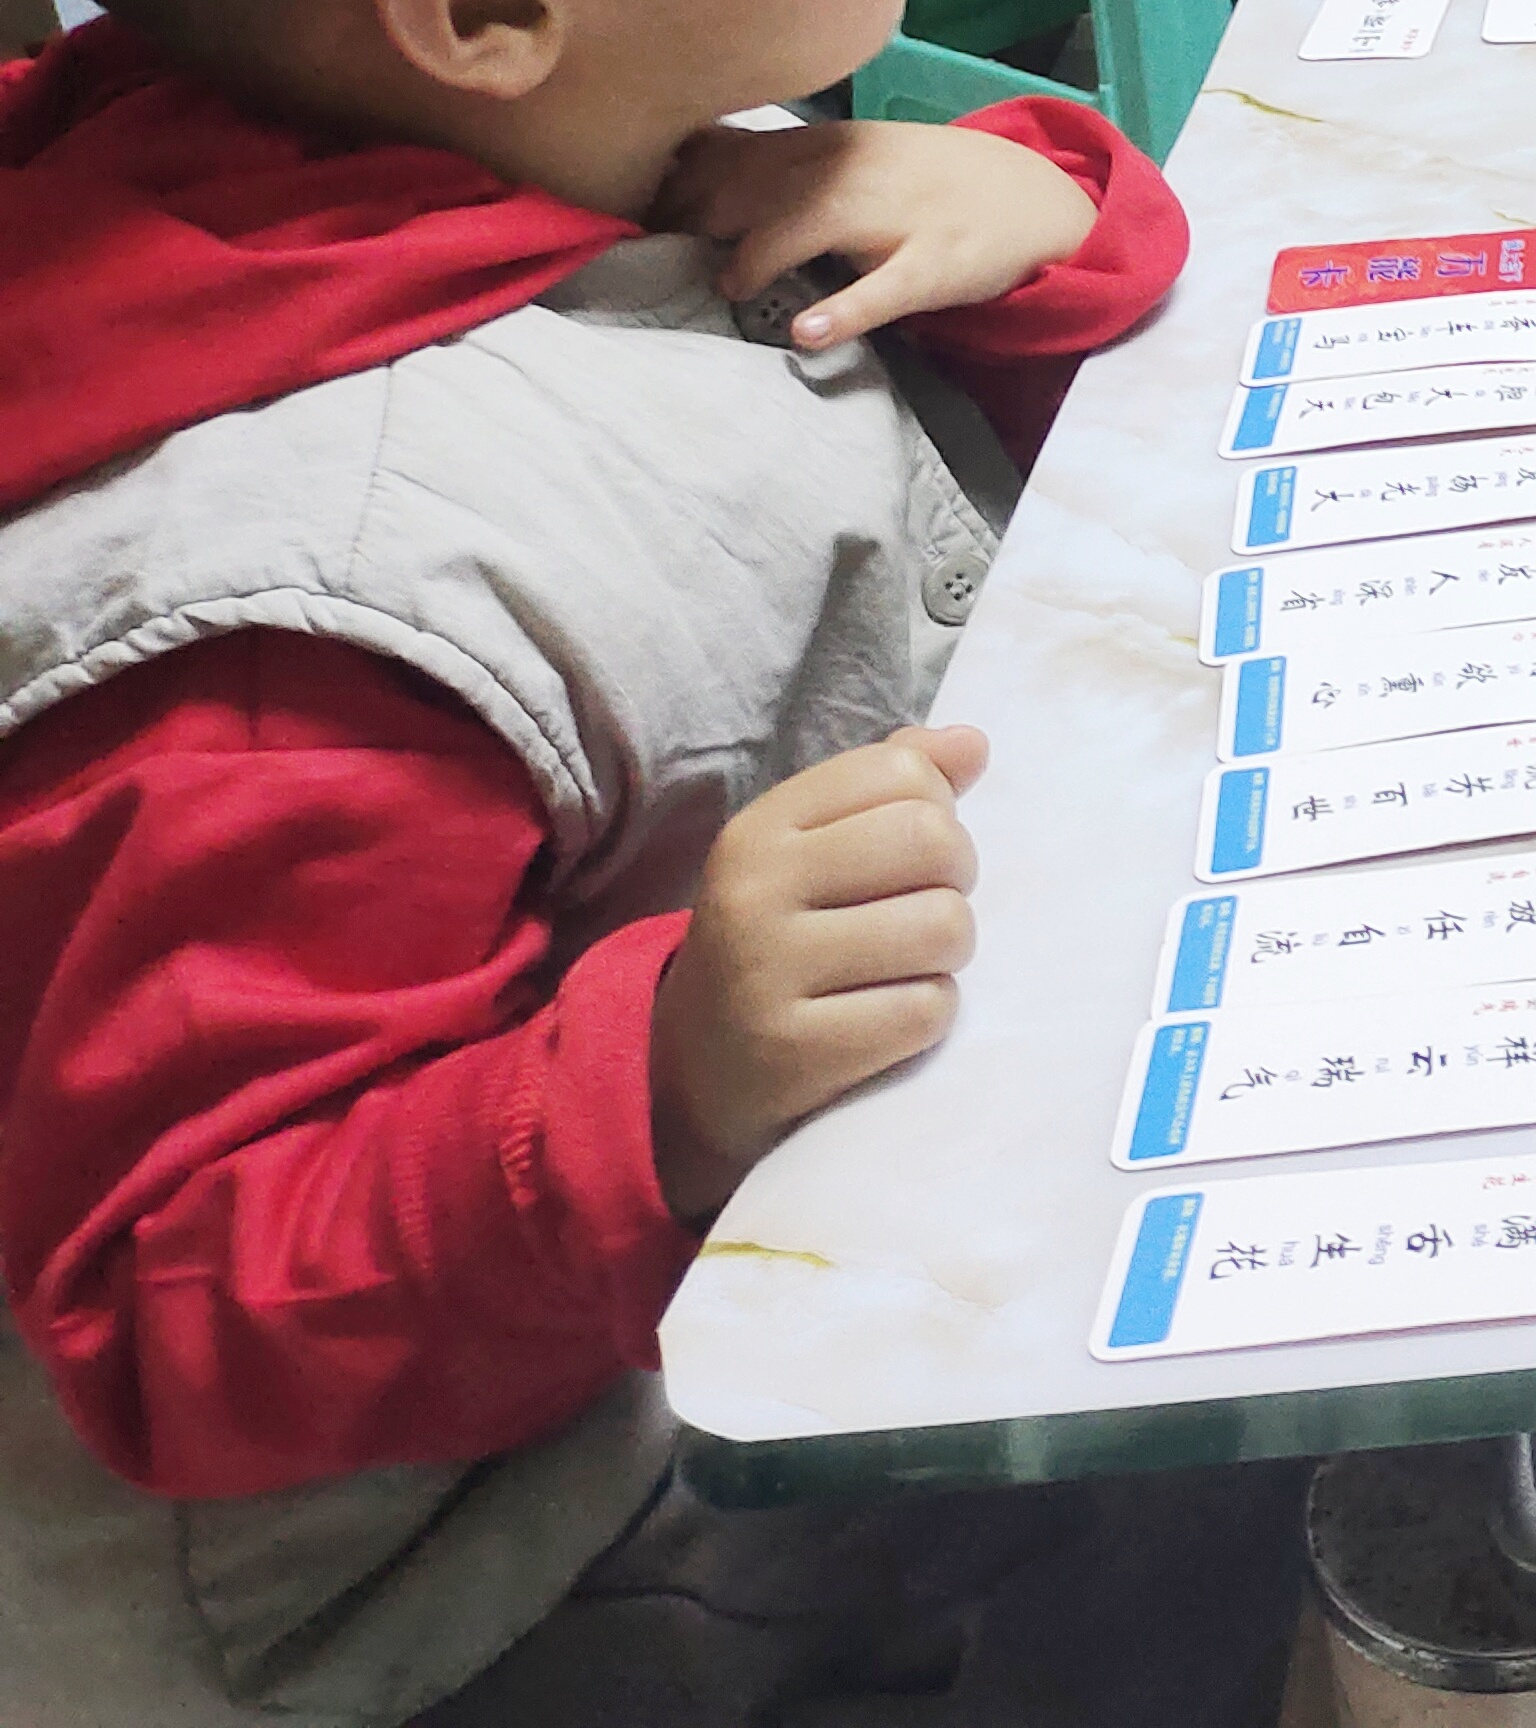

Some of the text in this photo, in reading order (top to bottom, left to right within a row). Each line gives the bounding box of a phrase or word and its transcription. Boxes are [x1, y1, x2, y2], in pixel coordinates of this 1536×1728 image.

[1300, 250, 1488, 289] 万能卡
[1298, 383, 1529, 420] 胆大包天
[1279, 564, 1536, 613] 发人深省
